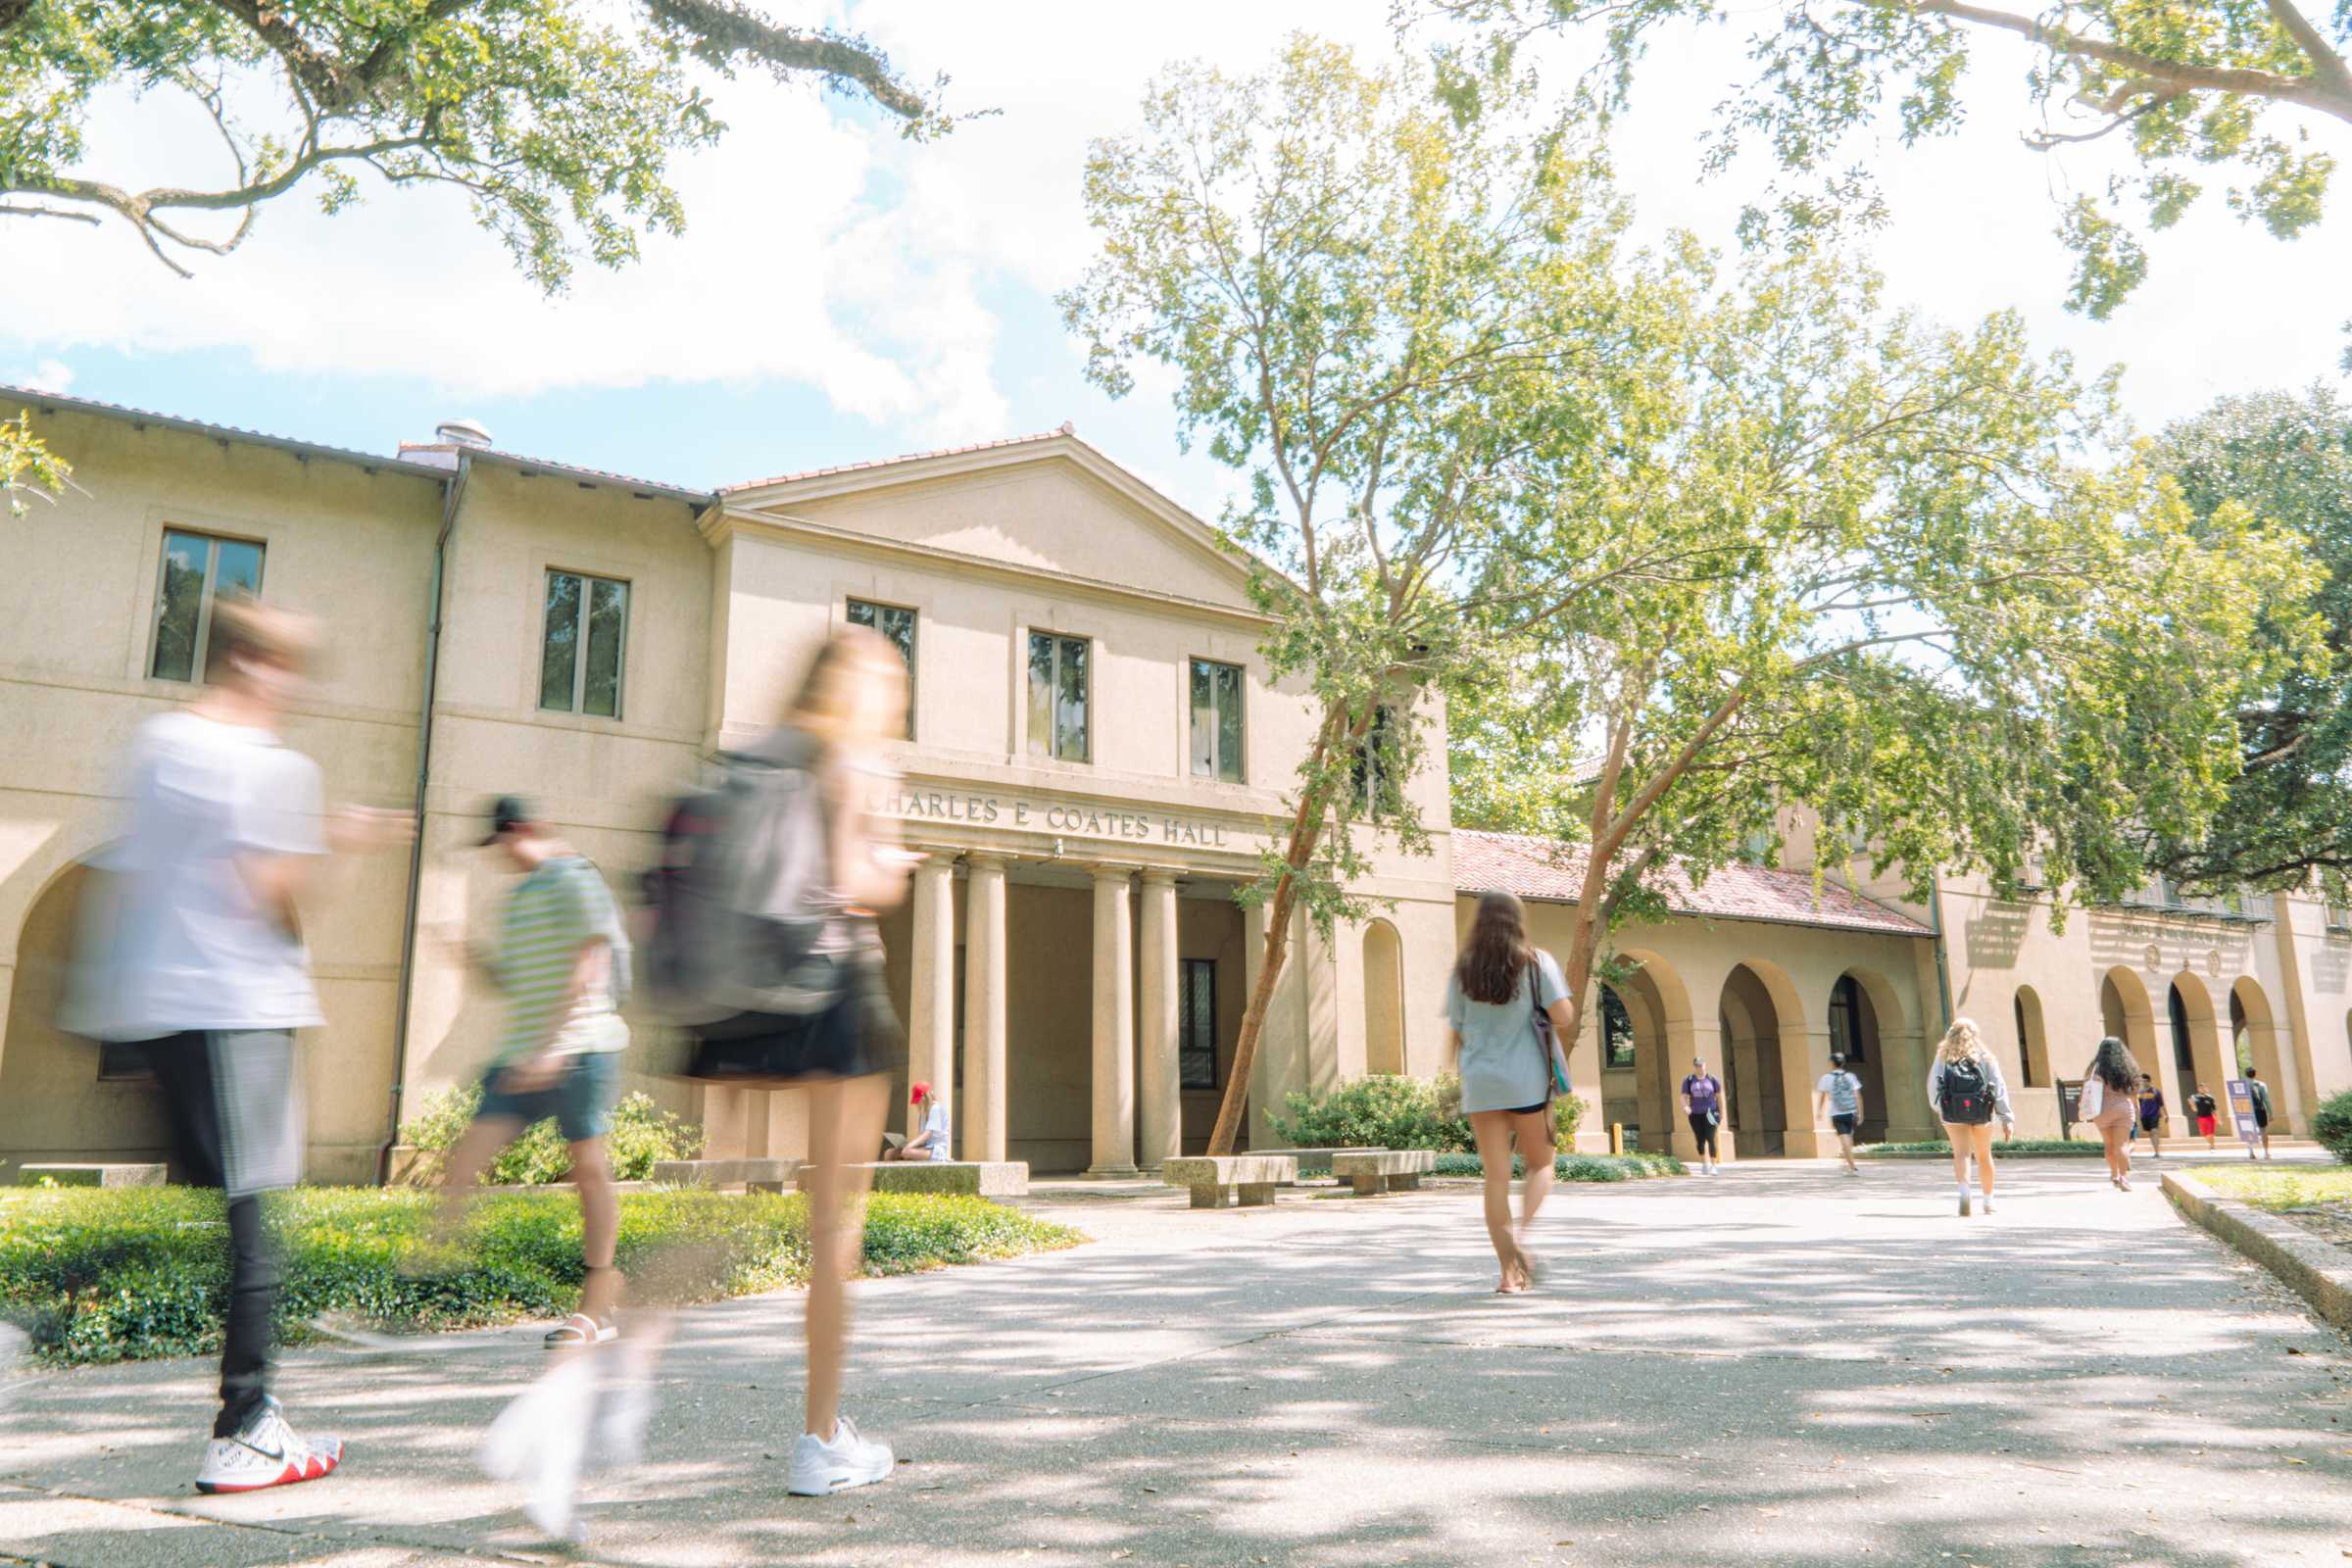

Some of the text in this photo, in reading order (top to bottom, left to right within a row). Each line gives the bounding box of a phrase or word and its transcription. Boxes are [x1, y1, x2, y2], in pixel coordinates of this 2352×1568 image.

[864, 789, 1227, 848] CHARLES E COATES HALL
